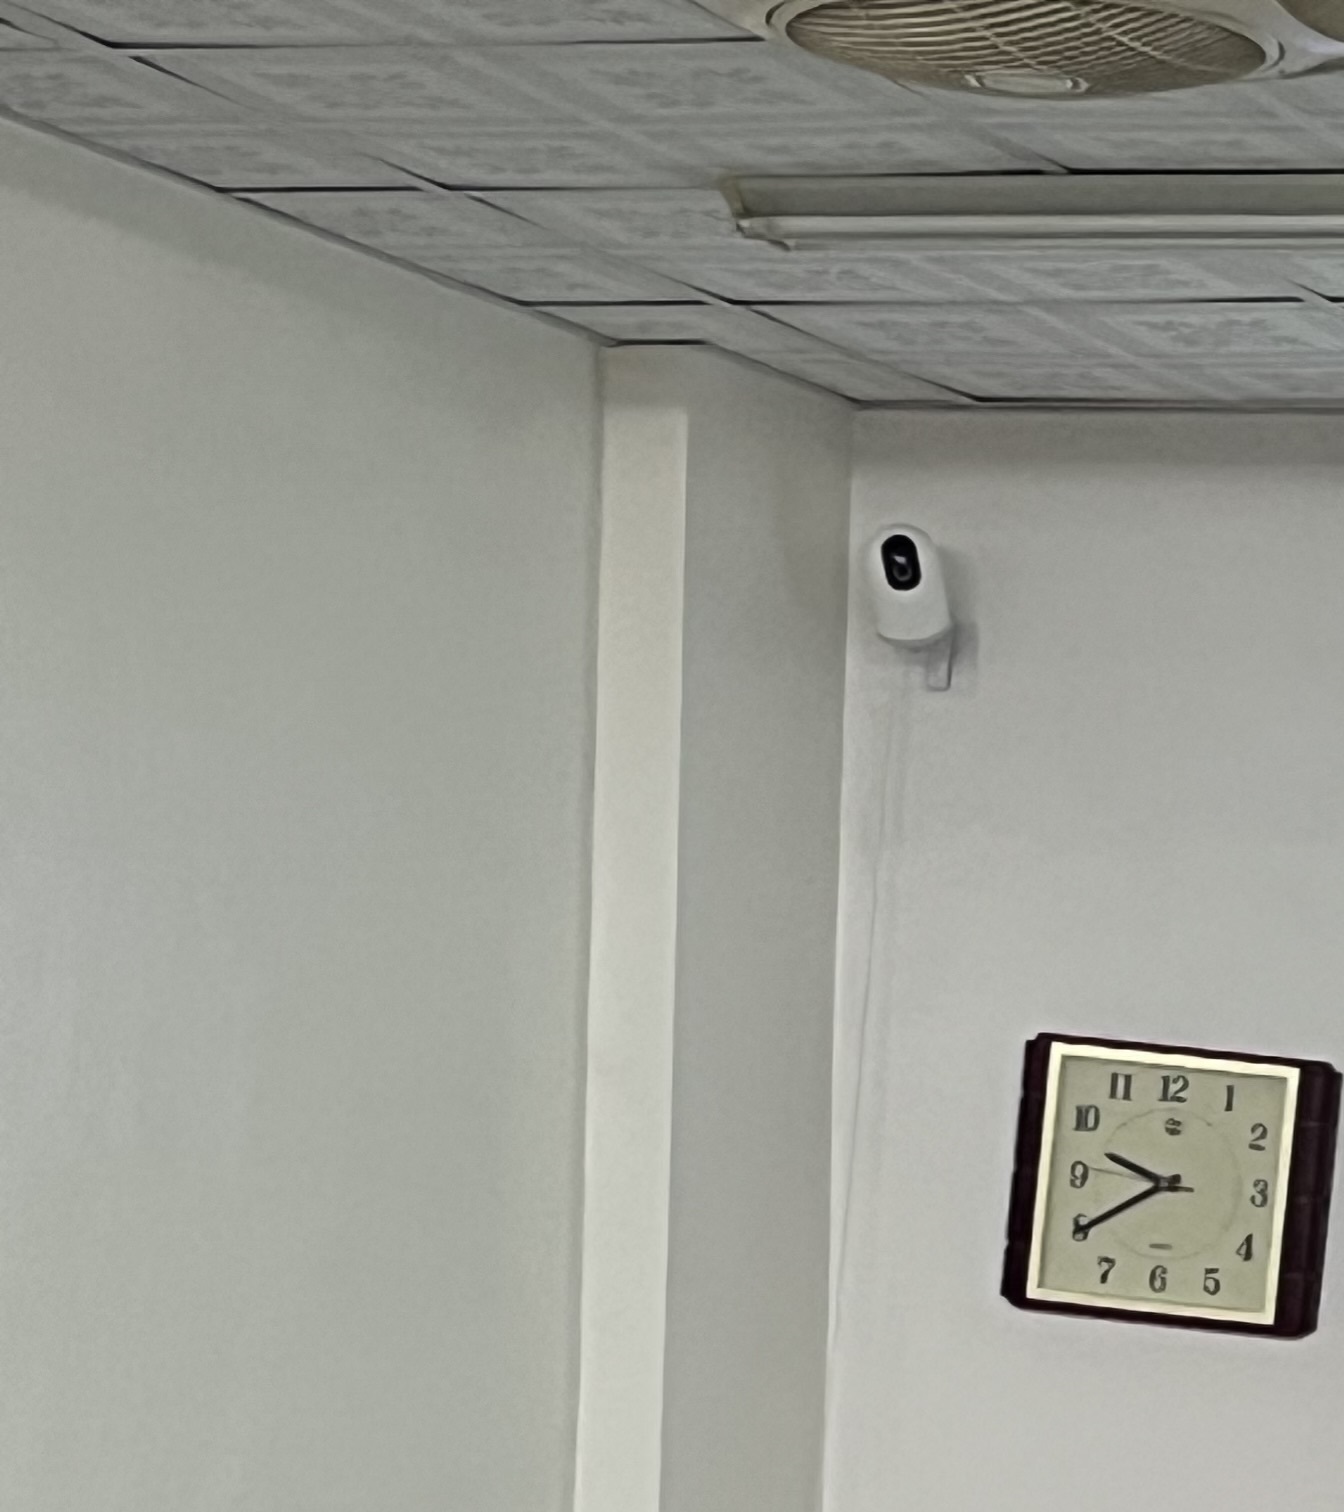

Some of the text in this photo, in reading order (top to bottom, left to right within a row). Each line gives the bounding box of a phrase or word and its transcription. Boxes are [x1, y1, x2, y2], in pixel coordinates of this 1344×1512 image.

[1109, 1072, 1133, 1101] 11
[1158, 1075, 1190, 1103] 12
[1224, 1085, 1235, 1112] 1
[1073, 1105, 1100, 1132] 10
[1249, 1123, 1268, 1151] 2
[1070, 1160, 1089, 1189] 9
[1250, 1179, 1269, 1208] 3
[1236, 1233, 1254, 1262] 4
[1097, 1256, 1116, 1284] 7
[1150, 1265, 1169, 1293] 6
[1203, 1268, 1221, 1296] 5
